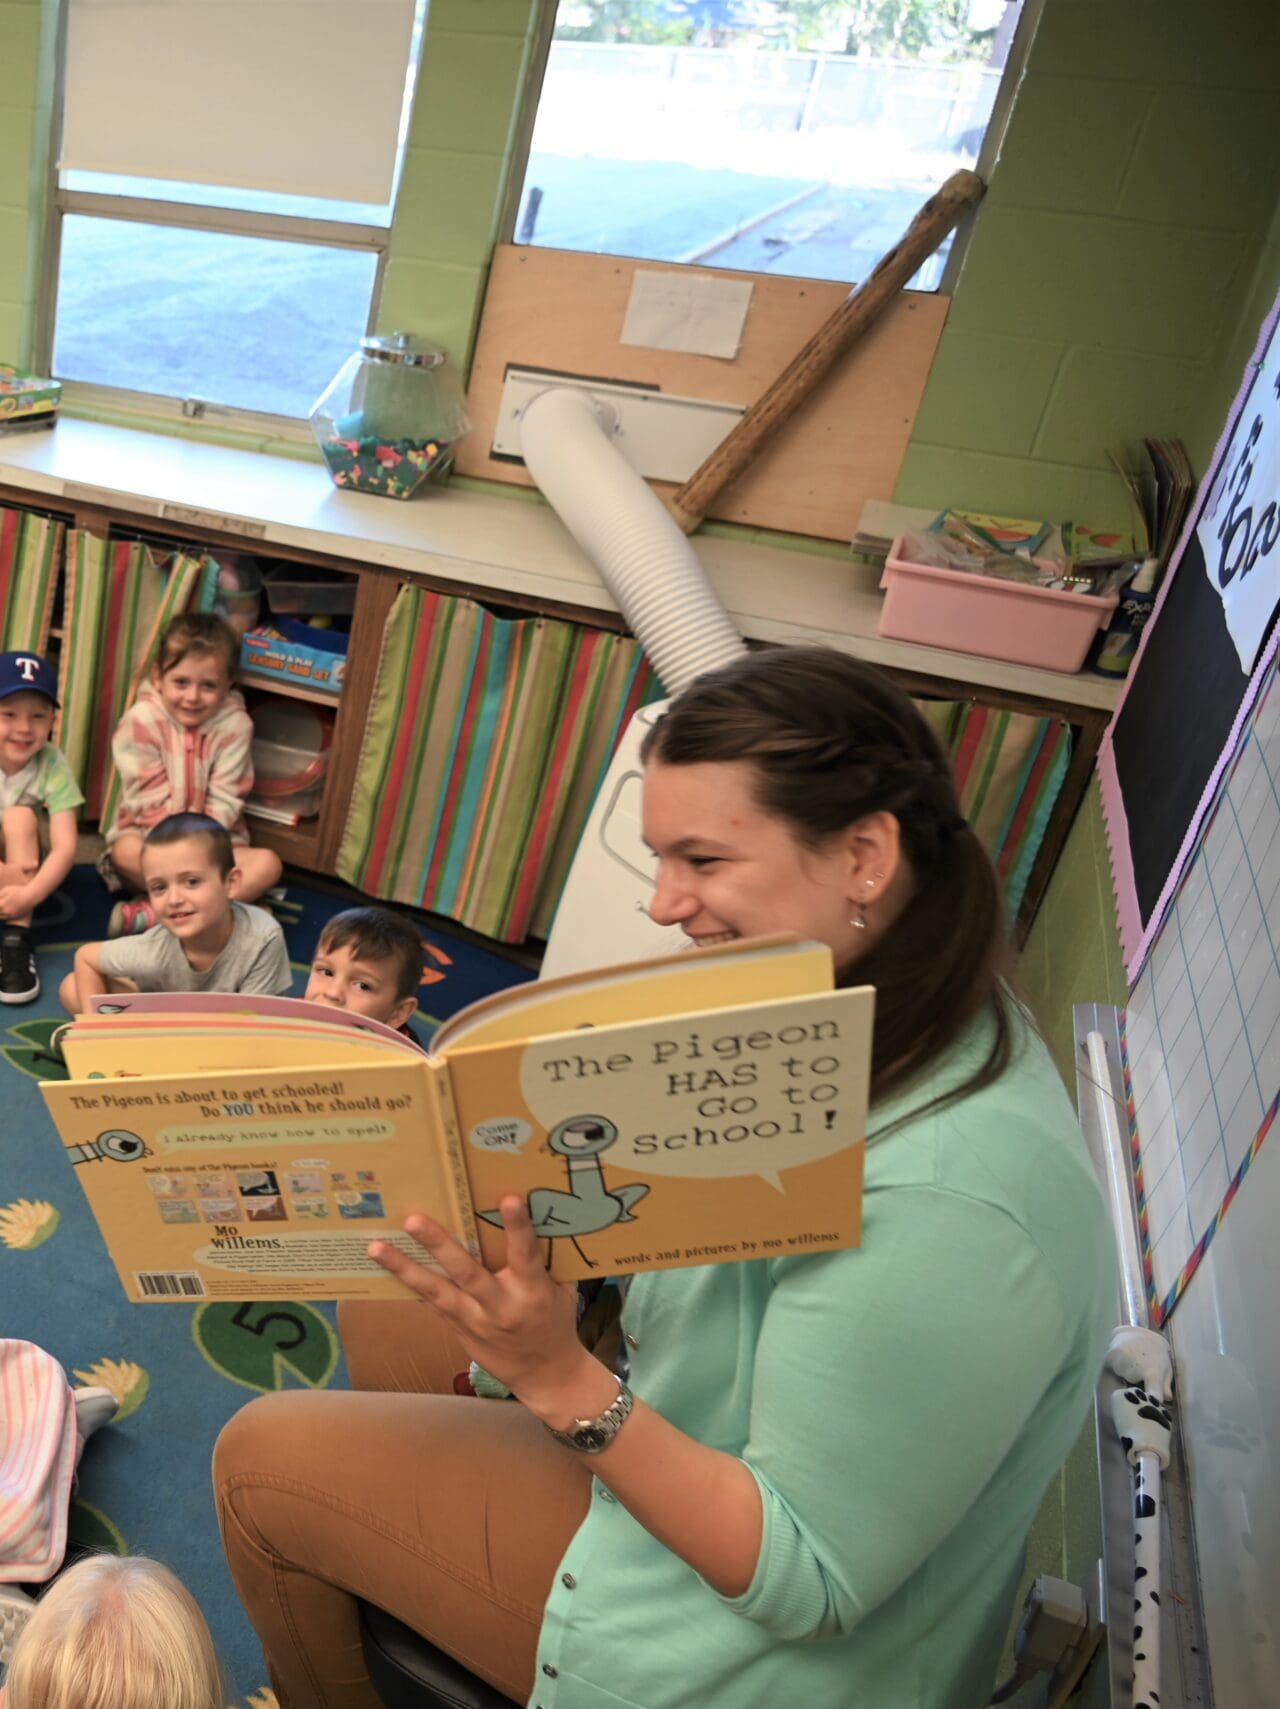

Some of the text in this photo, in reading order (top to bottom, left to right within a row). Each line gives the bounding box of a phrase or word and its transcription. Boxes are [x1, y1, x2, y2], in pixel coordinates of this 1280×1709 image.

[15, 657, 39, 680] T
[543, 1019, 840, 1083] The Pigeon
[666, 1055, 840, 1096] HAS to
[69, 1081, 345, 1110] The Pigeon is about to get schooled!
[781, 1084, 839, 1105] to
[200, 1095, 413, 1119] Do YOU think he should go?
[176, 1132, 235, 1144] already
[240, 1130, 278, 1141] know
[286, 1128, 315, 1137] how
[323, 1126, 340, 1136] to
[476, 1123, 519, 1137] Come
[484, 1132, 517, 1147] ON!
[214, 1225, 238, 1236] Mo
[614, 1231, 840, 1266] words and pictures by mo willems
[232, 1300, 308, 1350] 5
